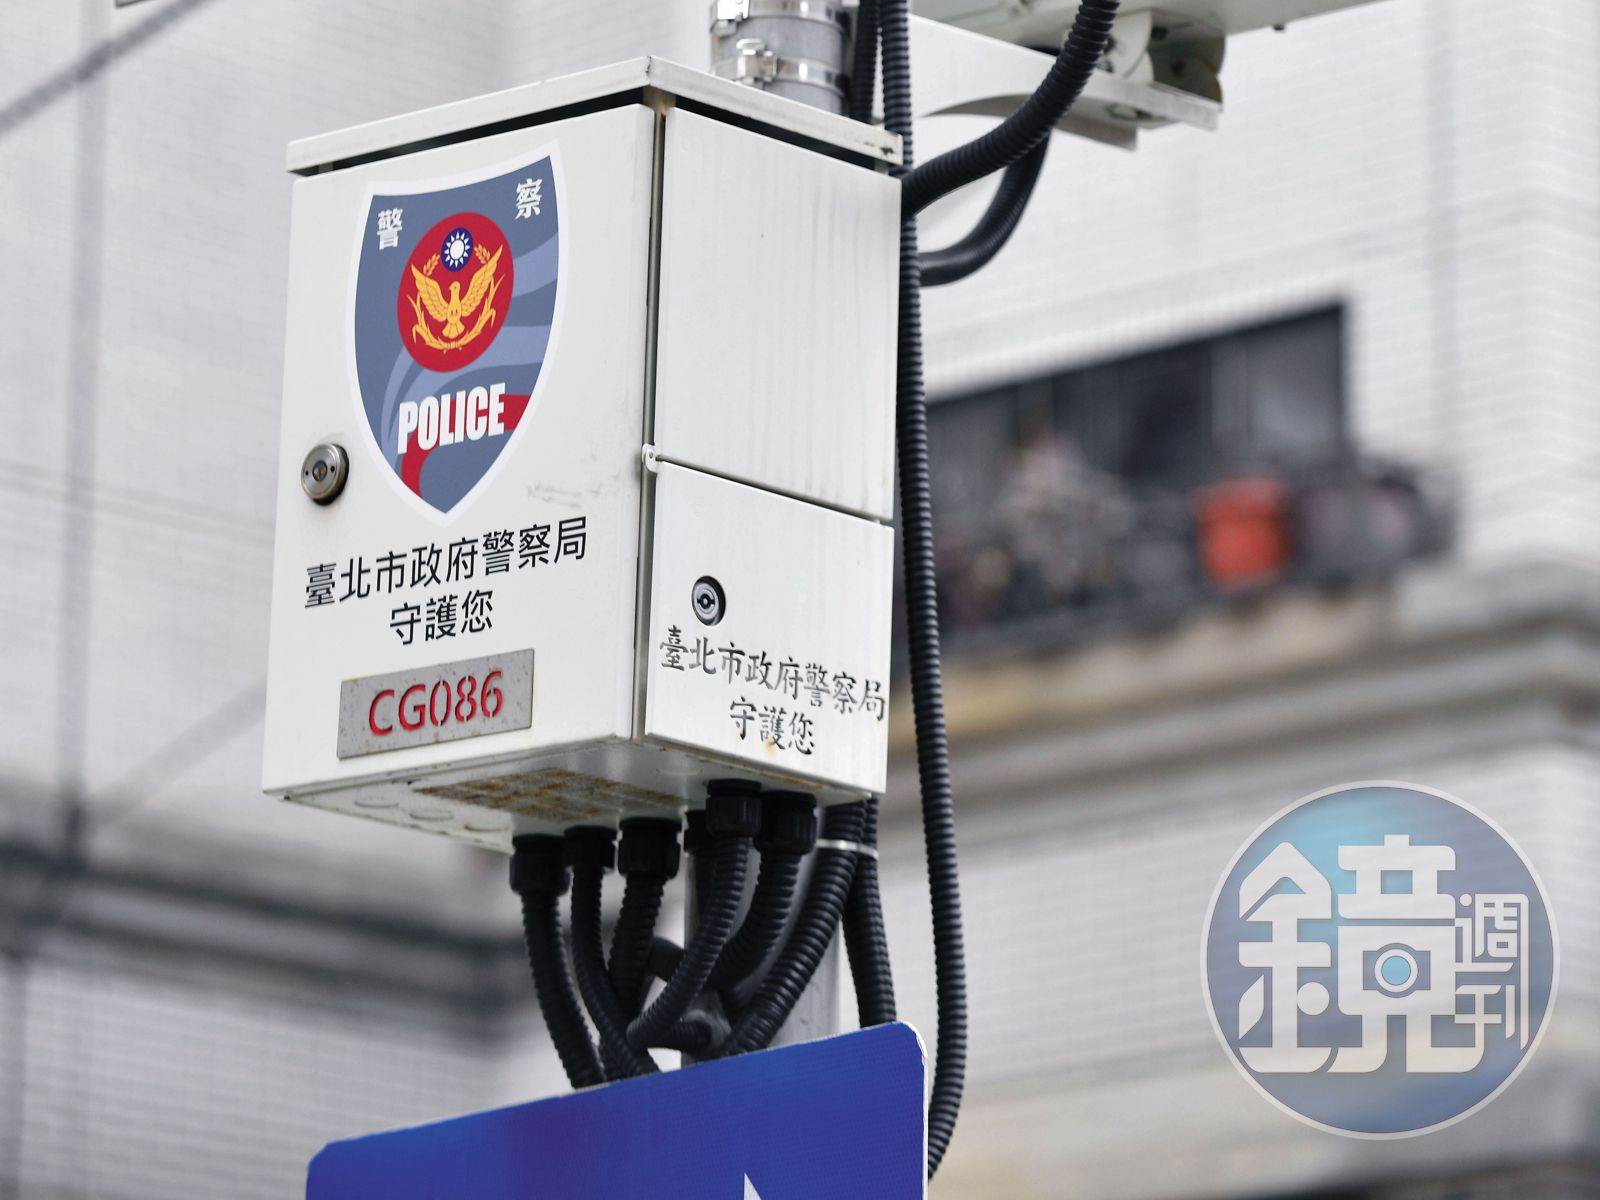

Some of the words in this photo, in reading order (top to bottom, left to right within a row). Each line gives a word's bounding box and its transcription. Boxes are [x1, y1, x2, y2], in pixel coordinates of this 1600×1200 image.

[397, 382, 506, 455] POLICE
[304, 516, 587, 609] 臺北市政府警察局
[390, 589, 493, 646] 守護您
[368, 670, 504, 737] CG086
[659, 624, 886, 722] 臺北市政府警察局
[730, 696, 815, 756] 守護您
